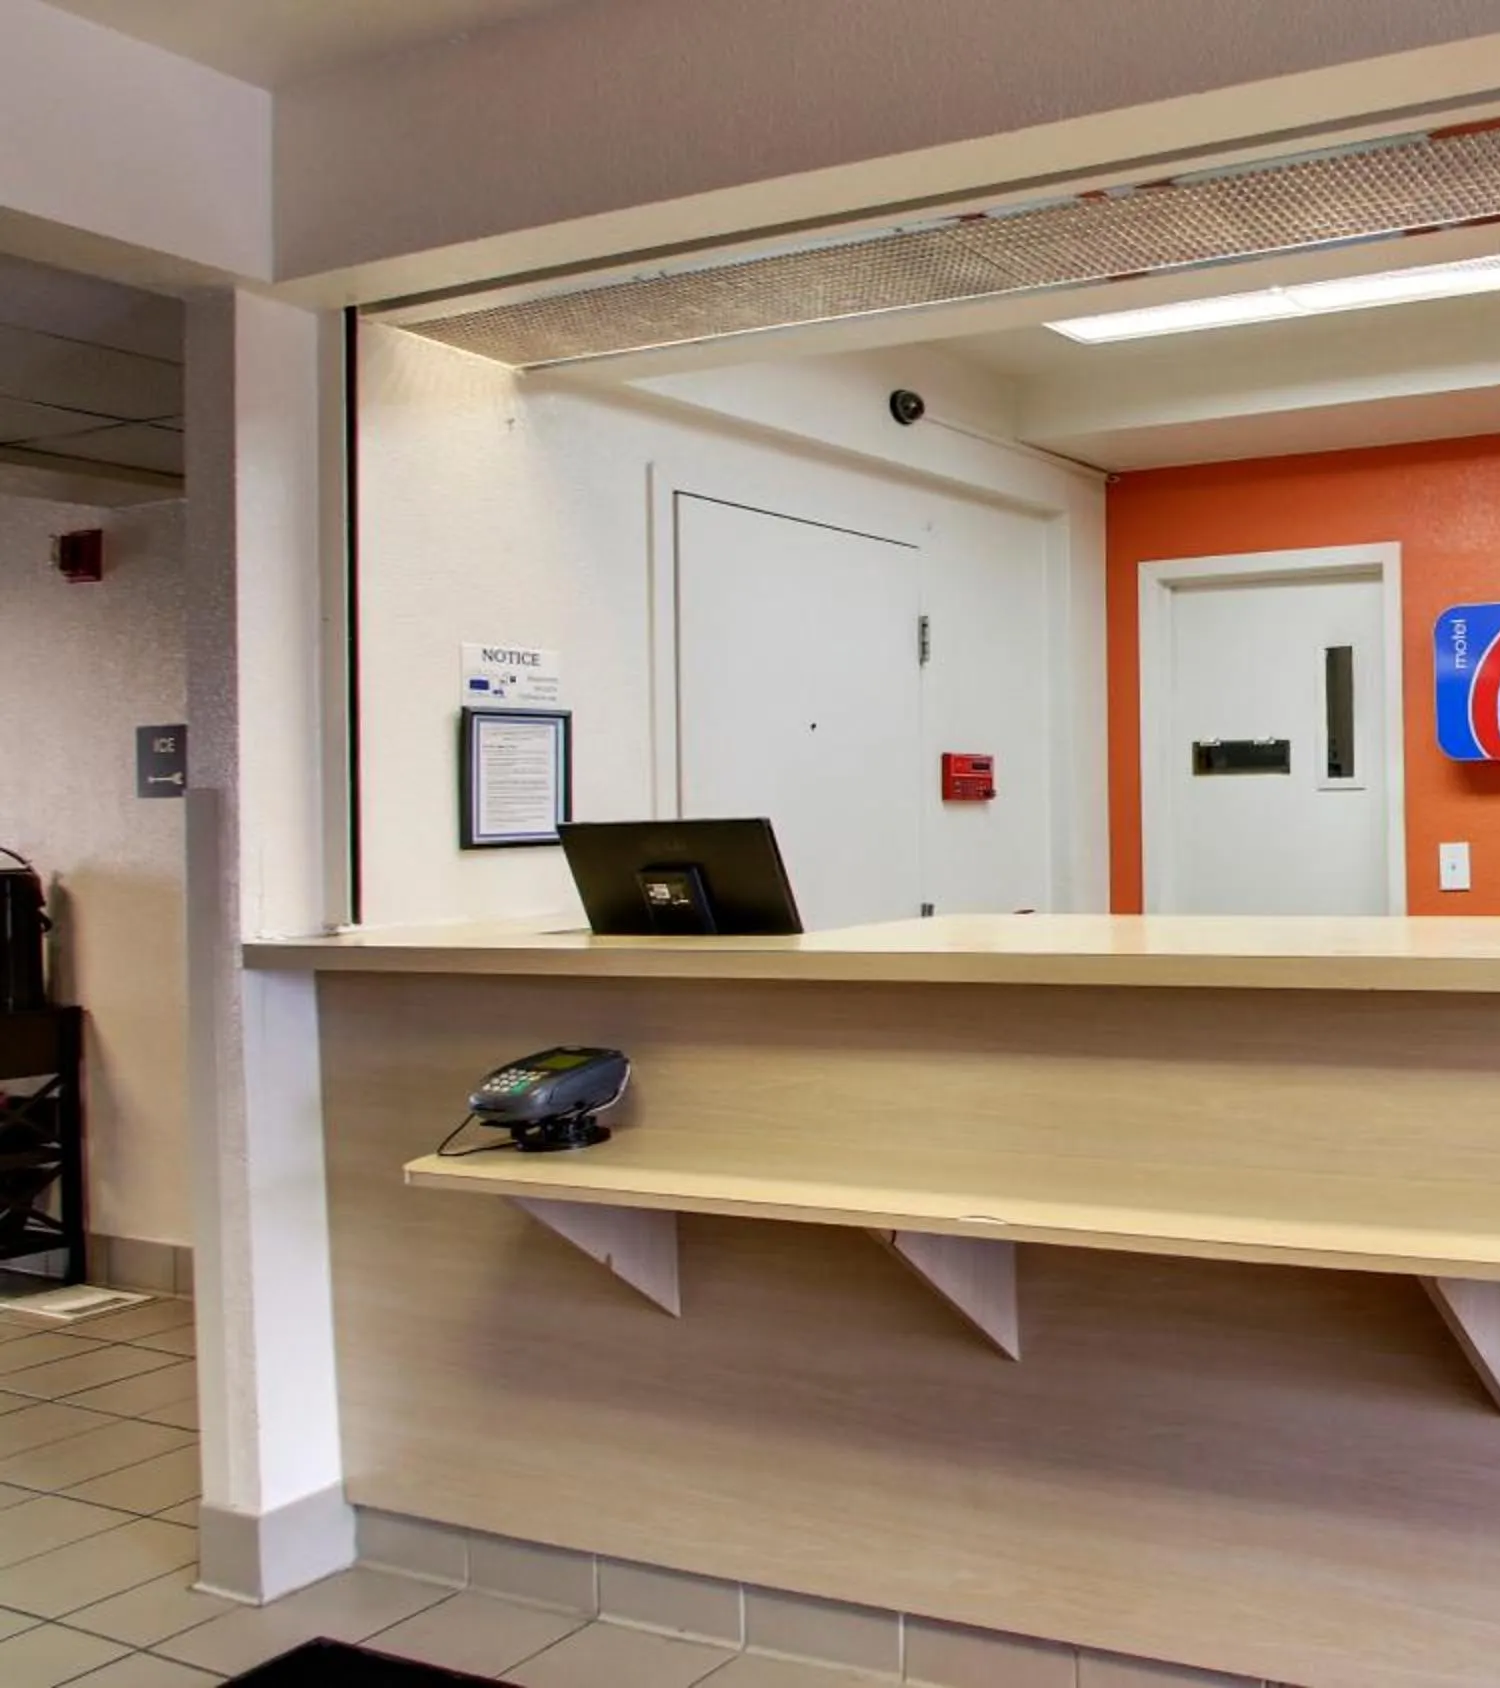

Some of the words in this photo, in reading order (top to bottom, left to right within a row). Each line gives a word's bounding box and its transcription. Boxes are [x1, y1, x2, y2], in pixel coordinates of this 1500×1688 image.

[1450, 619, 1468, 669] motel
[481, 648, 541, 667] NOTICE
[153, 737, 175, 752] ICE
